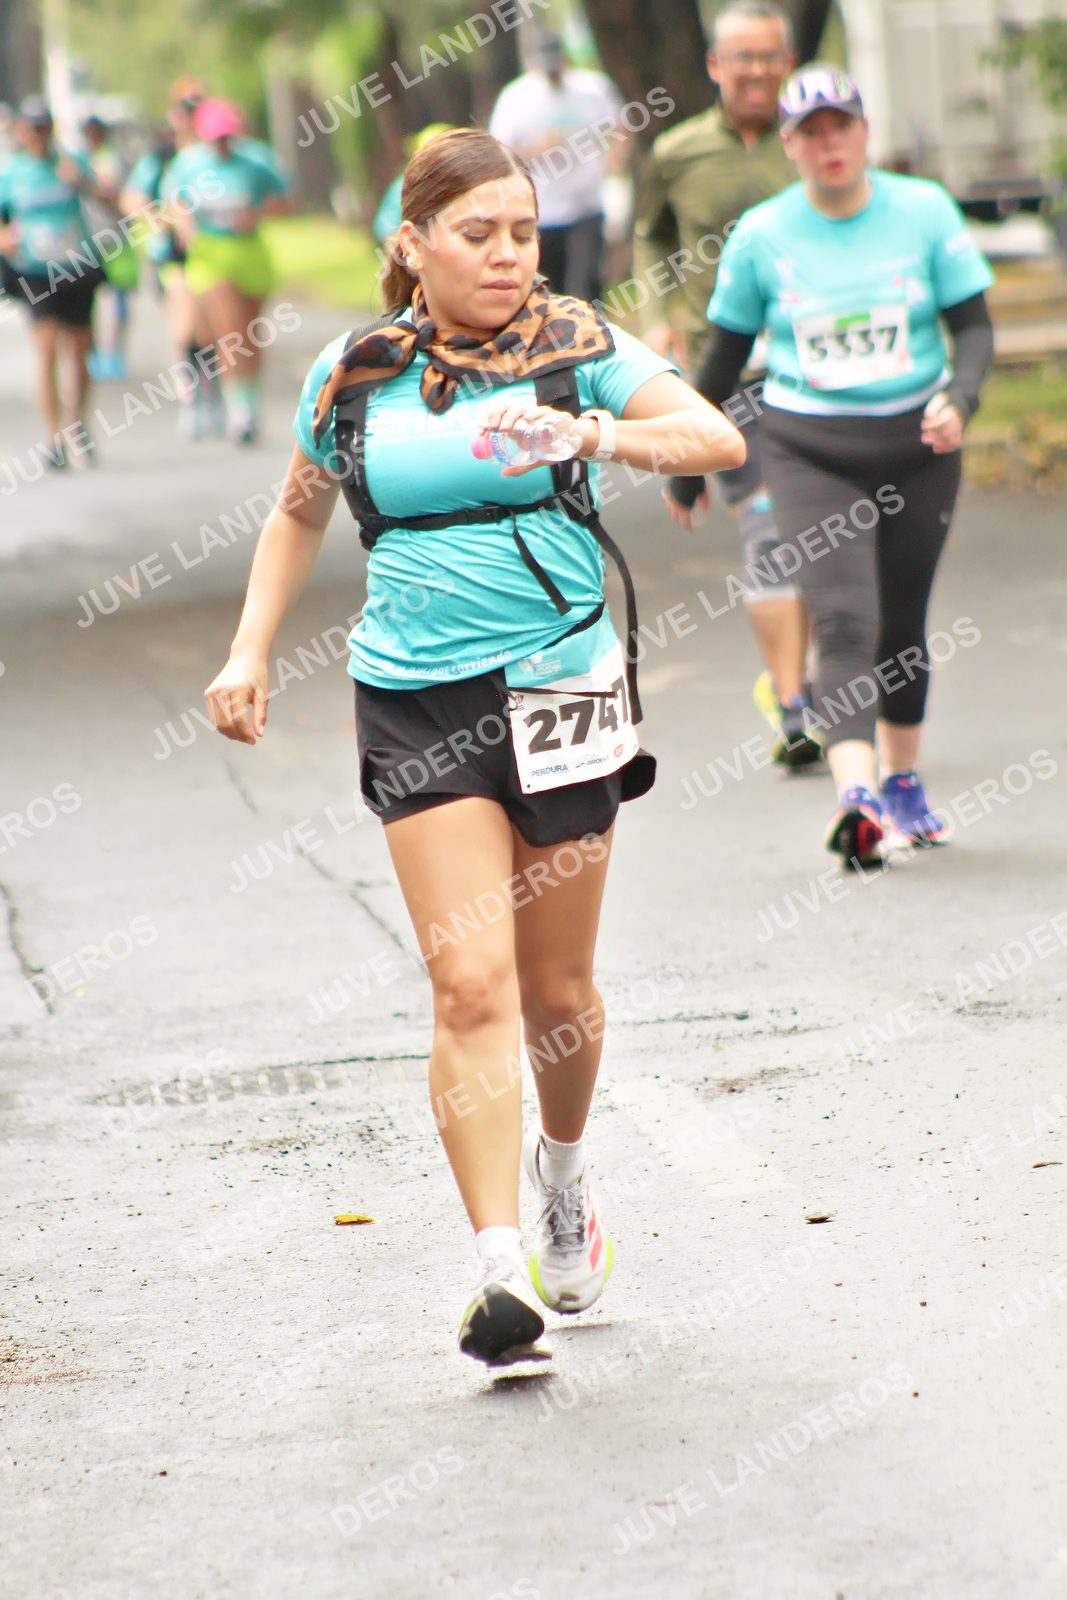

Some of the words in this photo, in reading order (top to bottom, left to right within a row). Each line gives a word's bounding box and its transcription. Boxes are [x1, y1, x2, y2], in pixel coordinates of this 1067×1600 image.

[807, 325, 899, 362] 5337
[523, 675, 628, 755] 2747
[530, 763, 569, 777] PERDURA
